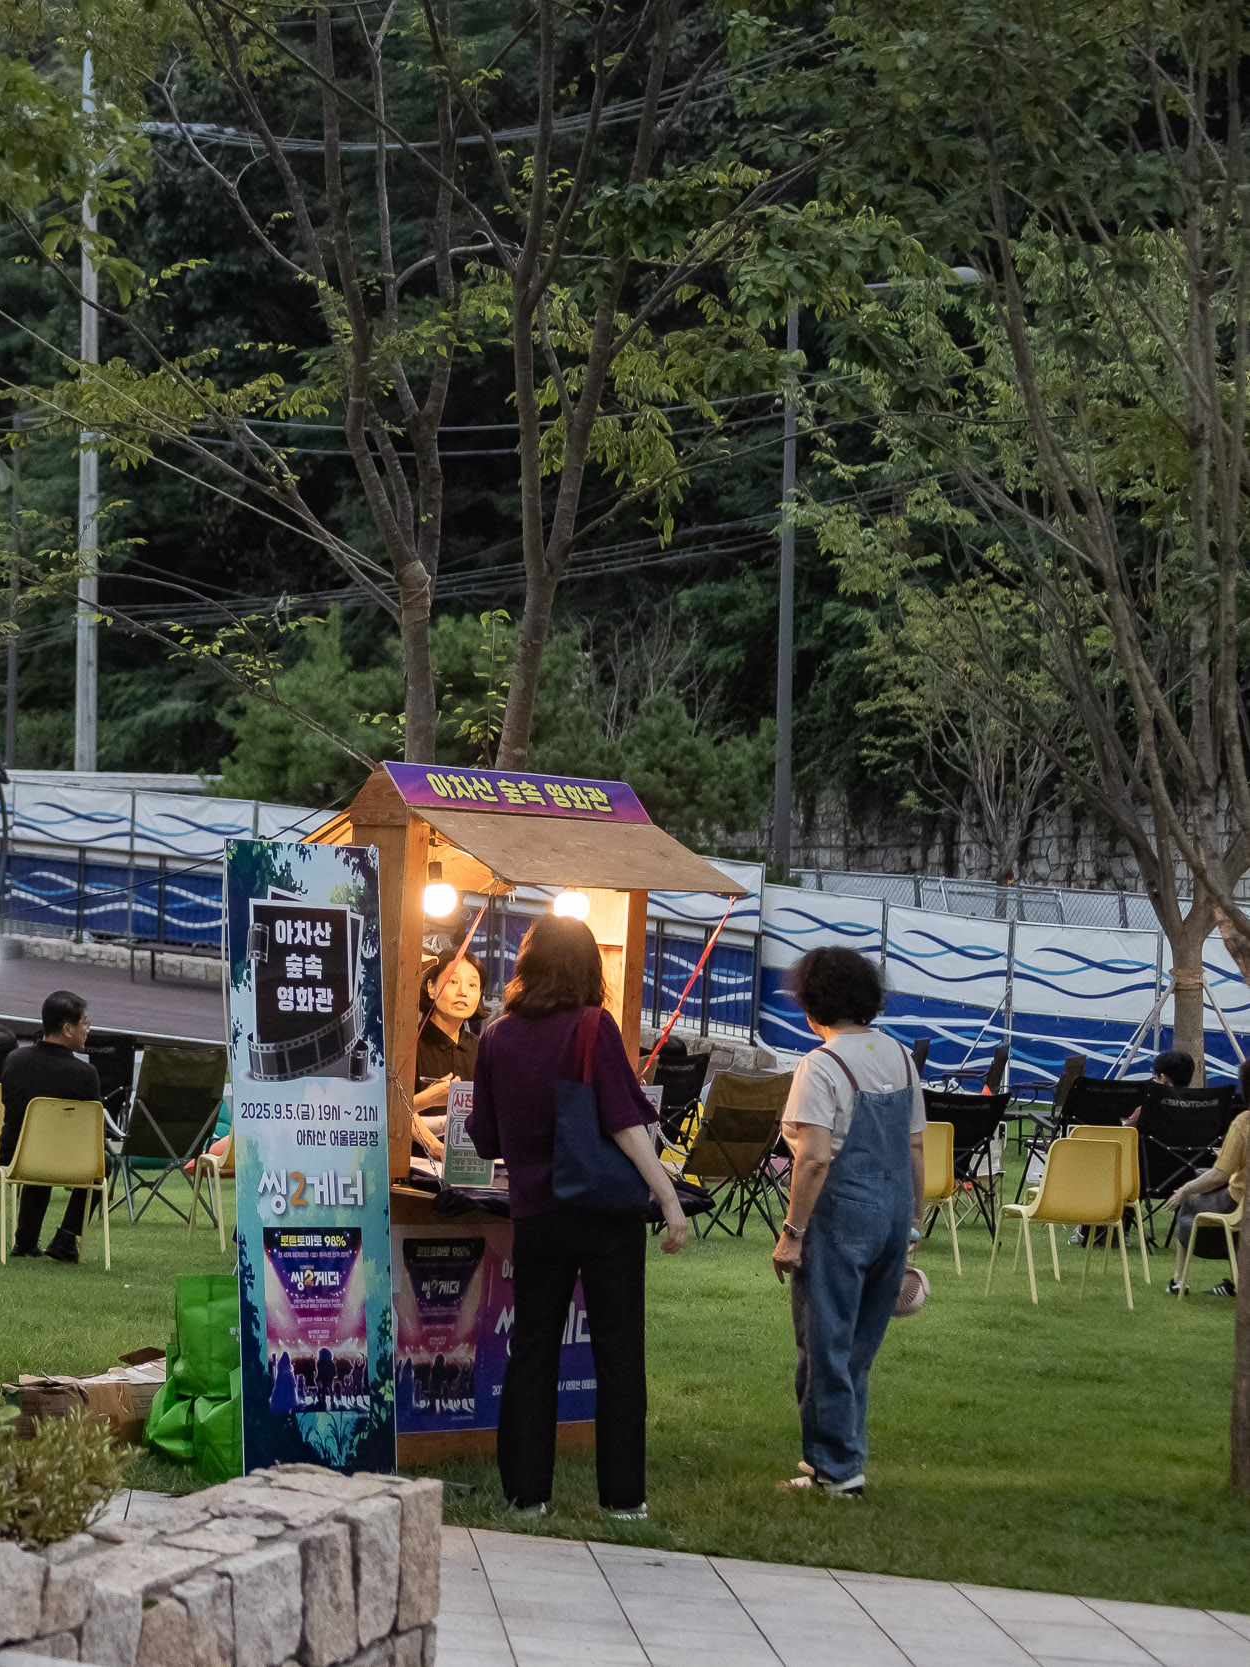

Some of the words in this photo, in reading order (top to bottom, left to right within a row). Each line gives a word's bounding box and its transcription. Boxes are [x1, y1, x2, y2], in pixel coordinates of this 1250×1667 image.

[426, 773, 499, 802] 아차산
[496, 778, 547, 806] 숲속
[544, 783, 613, 812] 영화관
[275, 919, 332, 947] 아차산
[285, 953, 323, 980] 숲속
[277, 986, 334, 1013] 영화관
[241, 1102, 315, 1121] 2025.9.5.(금)
[318, 1104, 341, 1121] 19시
[355, 1105, 378, 1122] 21시
[296, 1129, 326, 1146] 아차산
[330, 1130, 379, 1147] 어울림광장
[257, 1168, 364, 1215] 씽2게더
[324, 1236, 347, 1247] 98%
[290, 1269, 340, 1291] 씽2게더
